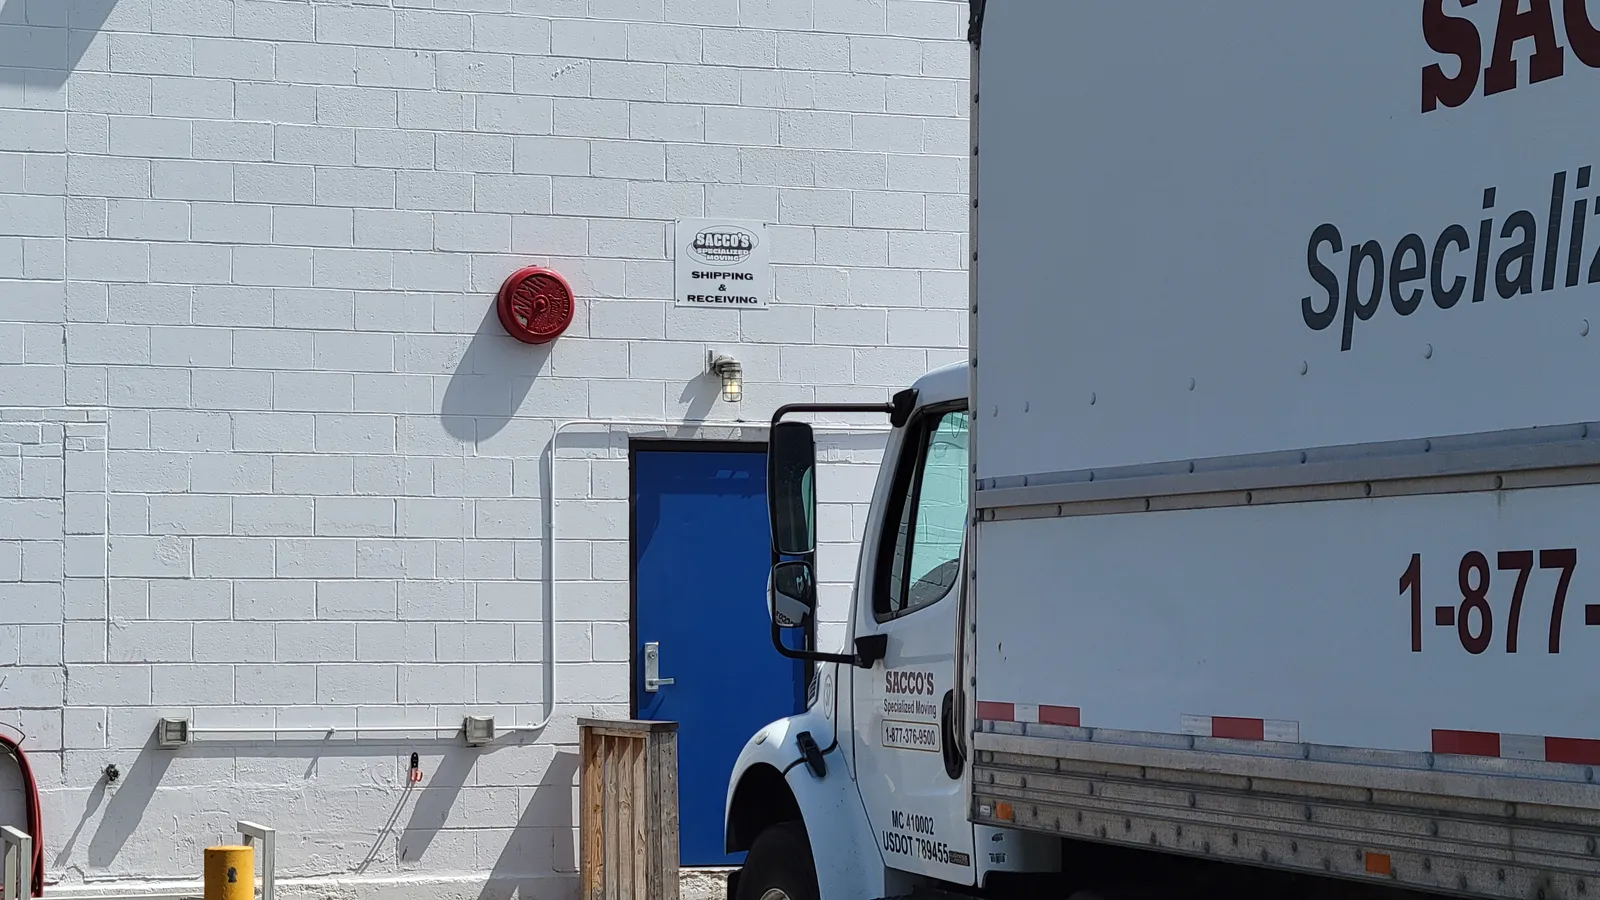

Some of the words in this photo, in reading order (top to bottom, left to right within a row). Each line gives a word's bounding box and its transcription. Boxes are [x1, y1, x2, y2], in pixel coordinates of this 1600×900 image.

[696, 232, 750, 247] SACCO'S
[691, 271, 754, 280] SHIPPING
[718, 283, 727, 292] &
[687, 294, 758, 304] RECEIVING
[885, 671, 935, 695] SACCO'S
[883, 698, 915, 715] Specialized
[915, 701, 937, 719] Moving
[885, 726, 936, 746] 1-877-376-9500
[891, 810, 904, 830] MC
[906, 813, 934, 836] 410002
[882, 830, 914, 857] USDOT
[916, 837, 949, 864] 789455
